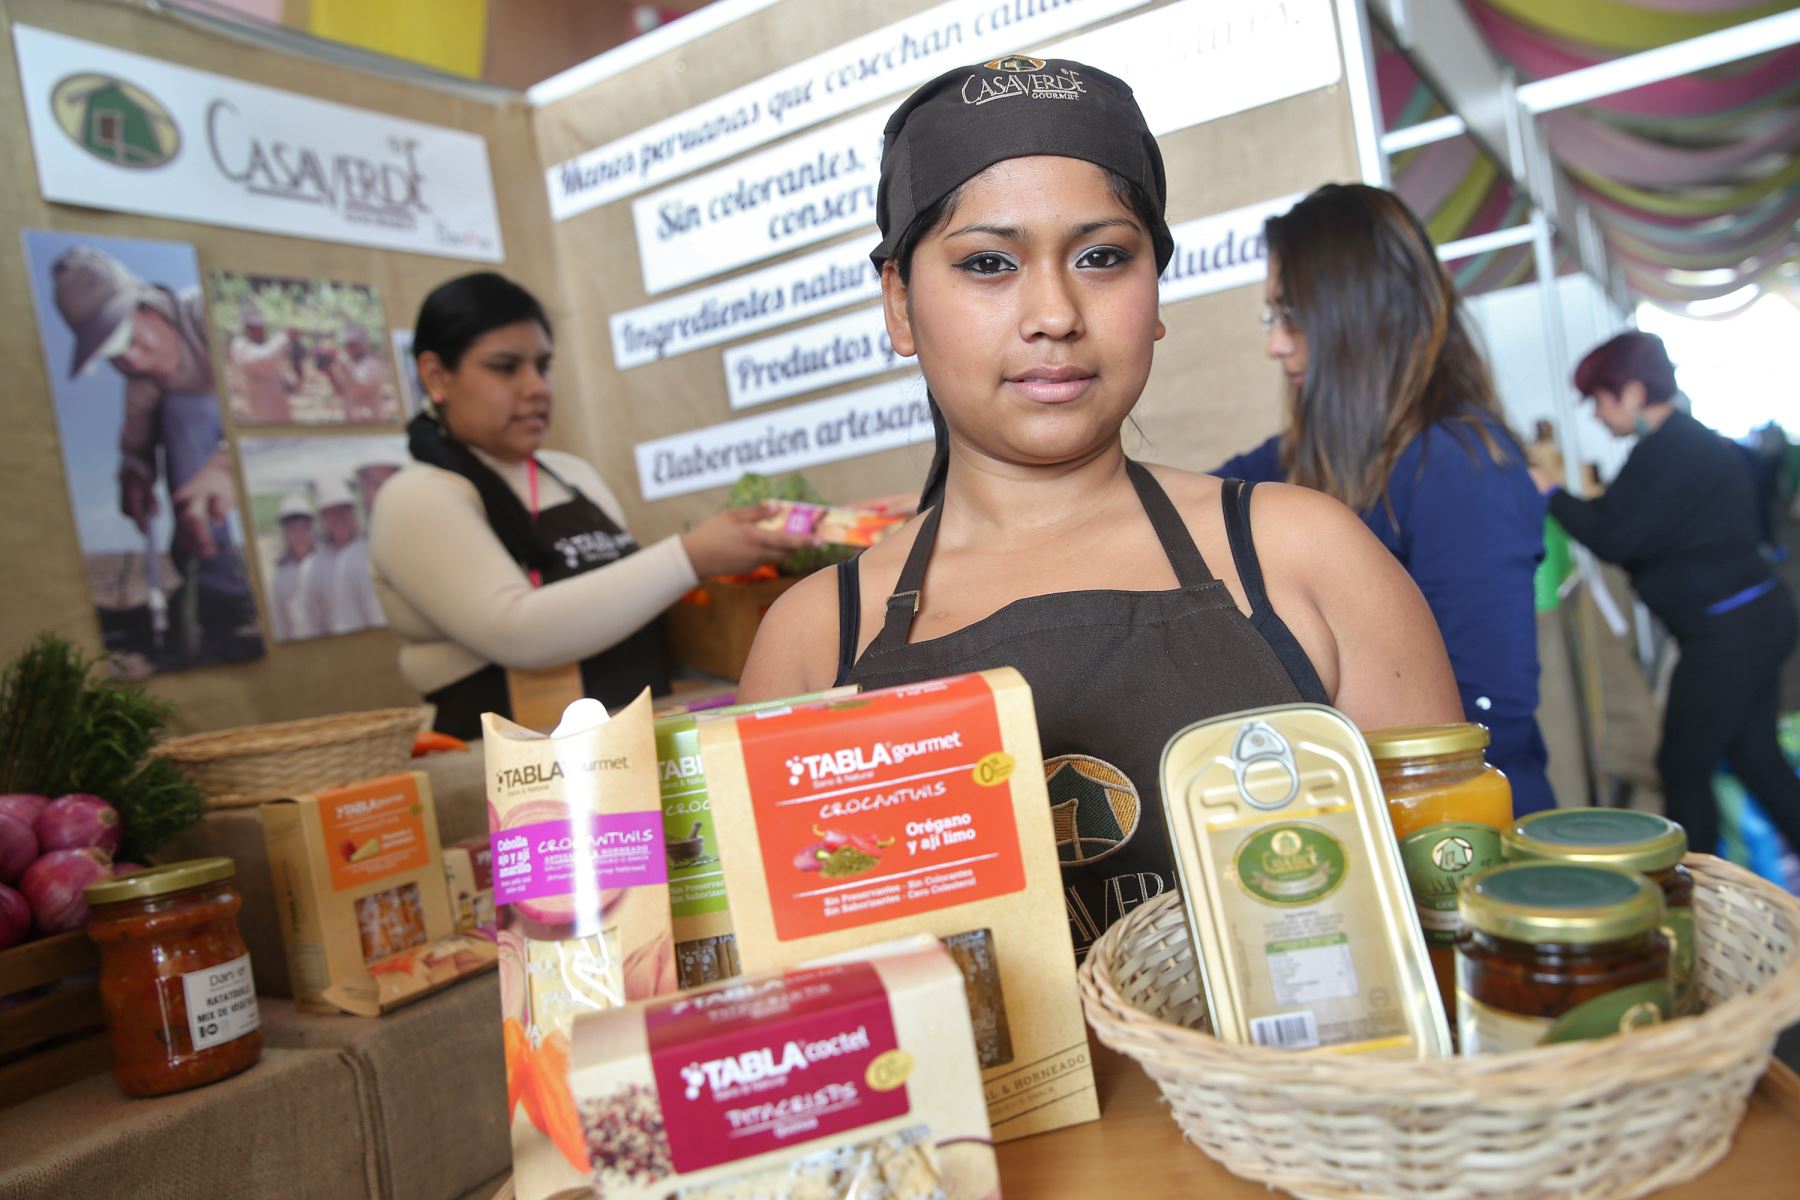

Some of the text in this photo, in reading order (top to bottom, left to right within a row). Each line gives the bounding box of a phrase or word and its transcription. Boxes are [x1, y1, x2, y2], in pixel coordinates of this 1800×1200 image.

[640, 101, 760, 177] peruanas
[768, 80, 813, 123] que
[825, 22, 962, 92] cosechan
[961, 70, 1087, 105] CASAVERDE
[1032, 91, 1080, 101] GOURMET
[657, 199, 700, 239] Sin
[622, 259, 880, 359] Ingredientes natur
[737, 334, 872, 391] Productos
[503, 760, 565, 788] TABLA
[802, 731, 963, 779] TABLA gourmet
[905, 813, 972, 835] Orégano
[906, 840, 917, 855] y
[942, 828, 976, 845] limo
[701, 1041, 808, 1090] TABLA
[804, 1025, 871, 1063] coctel
[1014, 1053, 1086, 1089] HORNEADO
